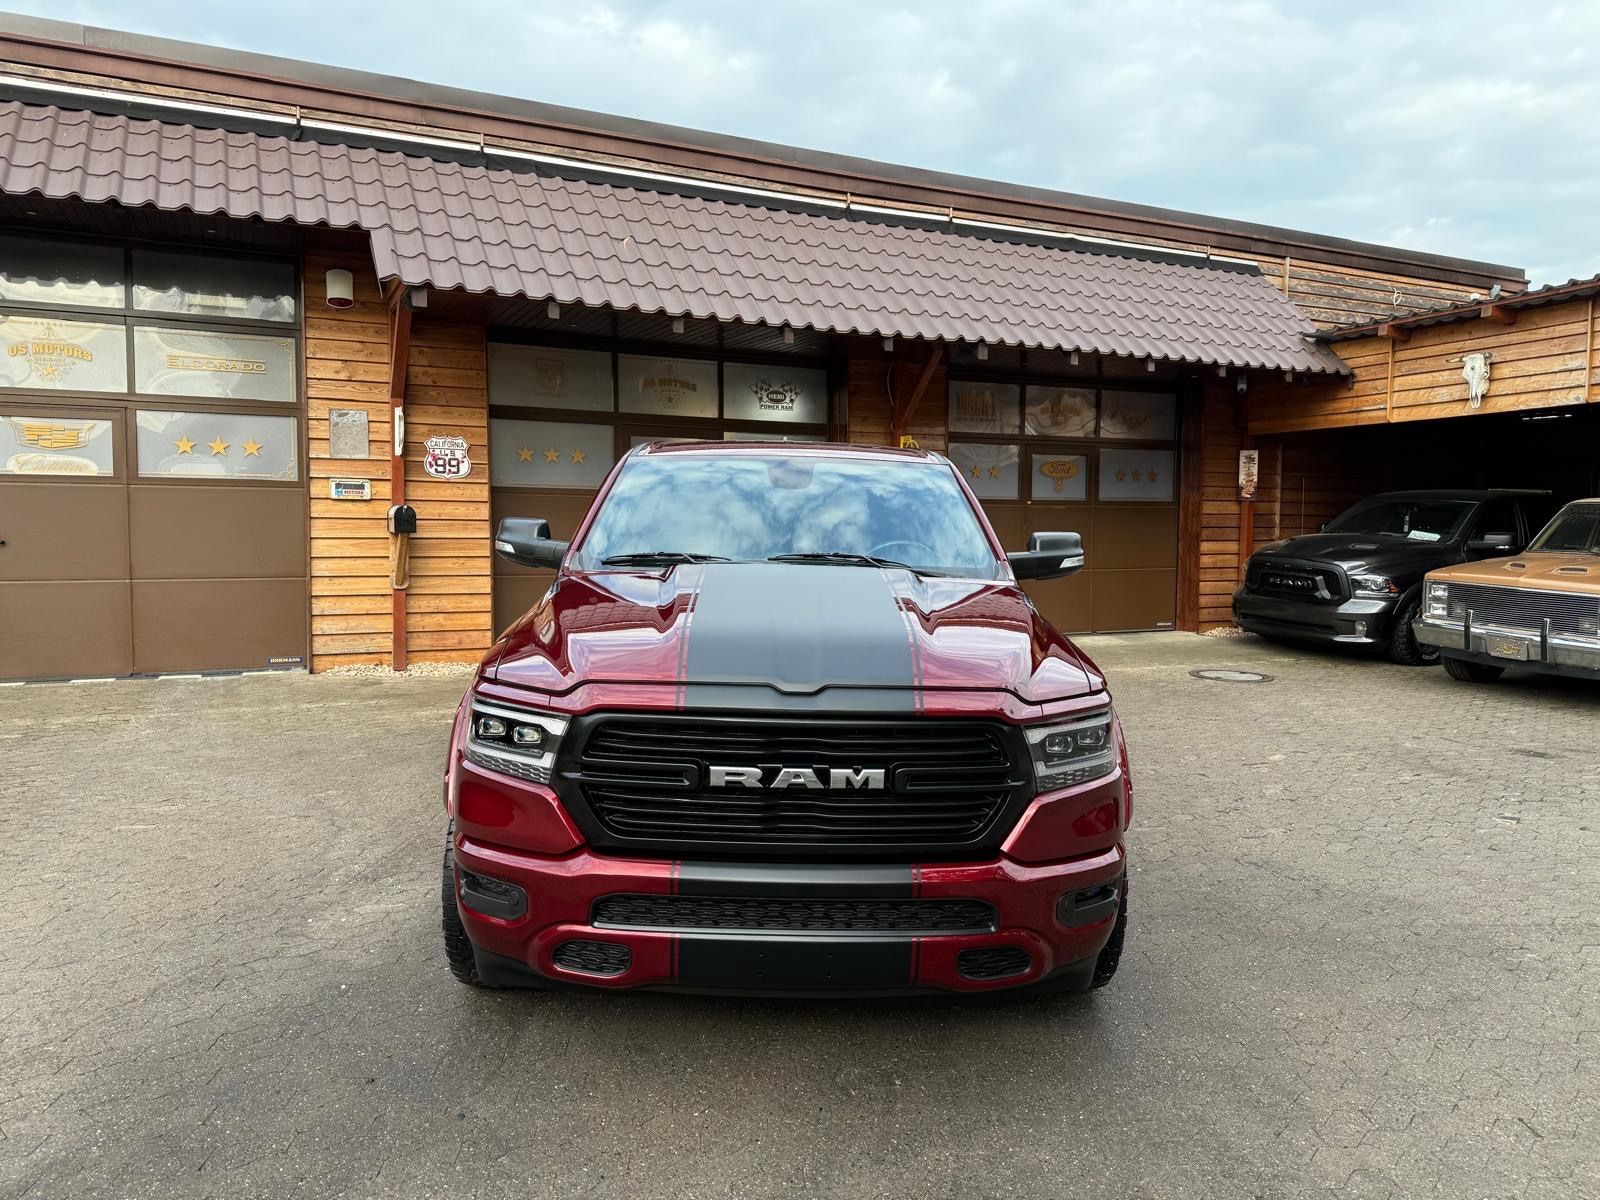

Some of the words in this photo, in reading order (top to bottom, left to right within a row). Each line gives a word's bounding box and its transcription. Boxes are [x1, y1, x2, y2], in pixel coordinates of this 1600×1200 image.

[8, 344, 28, 357] US
[31, 342, 93, 362] MOTORS
[167, 356, 266, 372] ELDORADO
[429, 440, 465, 449] CALIFORNIA
[434, 457, 460, 475] 99
[709, 765, 886, 789] RAM
